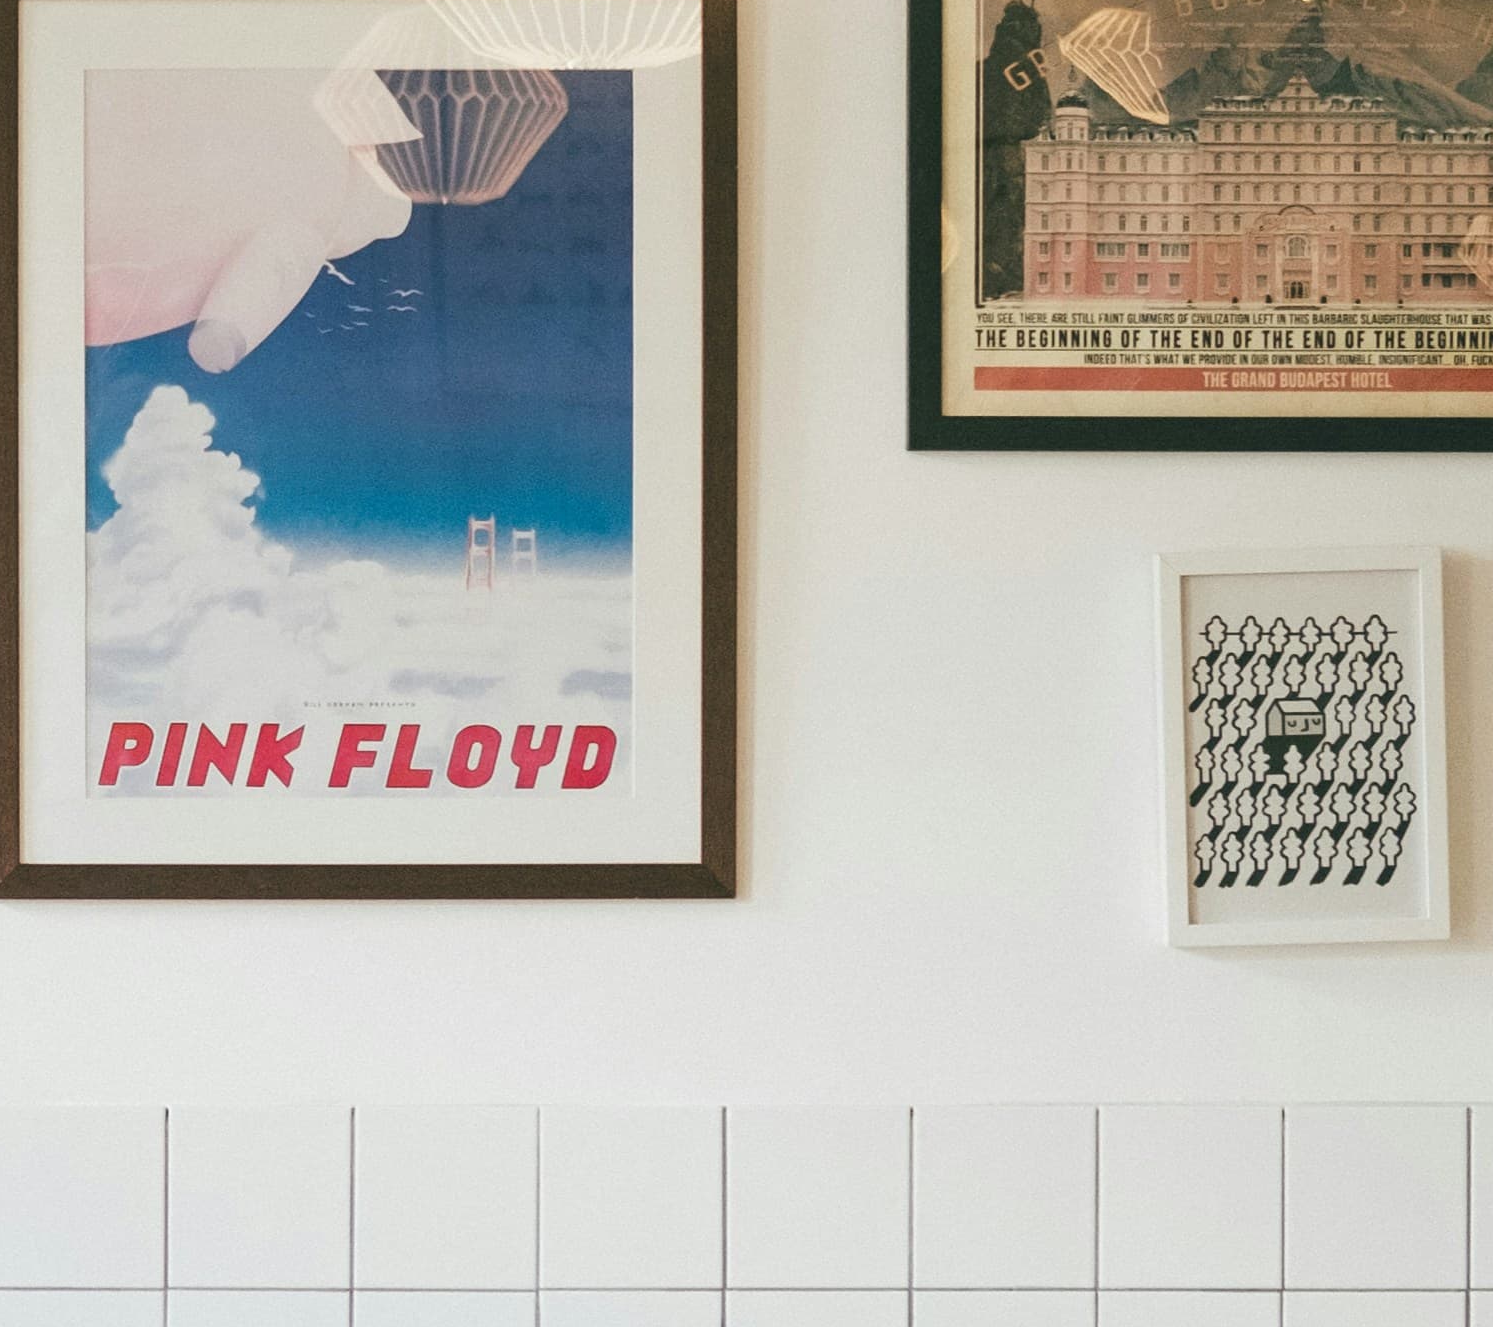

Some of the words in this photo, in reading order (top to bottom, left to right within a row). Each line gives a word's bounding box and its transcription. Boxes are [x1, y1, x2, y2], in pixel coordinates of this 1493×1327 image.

[977, 313, 994, 323] YOU
[1020, 313, 1047, 323] THERE
[1051, 313, 1068, 323] ARE
[1072, 313, 1094, 324] STILL
[1098, 313, 1124, 324] FAINT
[1127, 313, 1175, 324] GLIMMERS
[1178, 313, 1189, 324] OF
[1191, 313, 1250, 324] CIVILIZATION
[1253, 313, 1273, 324] LEFT
[1276, 313, 1286, 324] IN
[1289, 314, 1310, 325] THIS
[1445, 314, 1469, 325] THAT
[1471, 314, 1491, 325] WAS
[975, 330, 1007, 348] THE
[1016, 330, 1112, 348] BEGINNING
[1121, 330, 1141, 348] OF
[1150, 330, 1182, 349] THE
[1191, 330, 1224, 349] END
[1233, 330, 1253, 349] OF
[1262, 330, 1294, 349] THE
[1303, 331, 1336, 349] END
[1345, 331, 1365, 349] OF
[1374, 331, 1406, 349] THE
[1084, 354, 1117, 364] INDEED
[1153, 354, 1179, 364] WHAT
[1183, 354, 1196, 364] WE
[1199, 354, 1236, 364] PROVIDE
[1239, 354, 1249, 365] IN
[1271, 354, 1292, 365] OWN
[1471, 354, 1493, 365] FUCK
[1202, 371, 1230, 388] THE
[1232, 371, 1276, 388] GRAND
[1279, 371, 1348, 388] BUDAPEST
[1351, 372, 1393, 388] HOTEL
[98, 721, 306, 789] PINK
[327, 722, 618, 790] FLOYD
